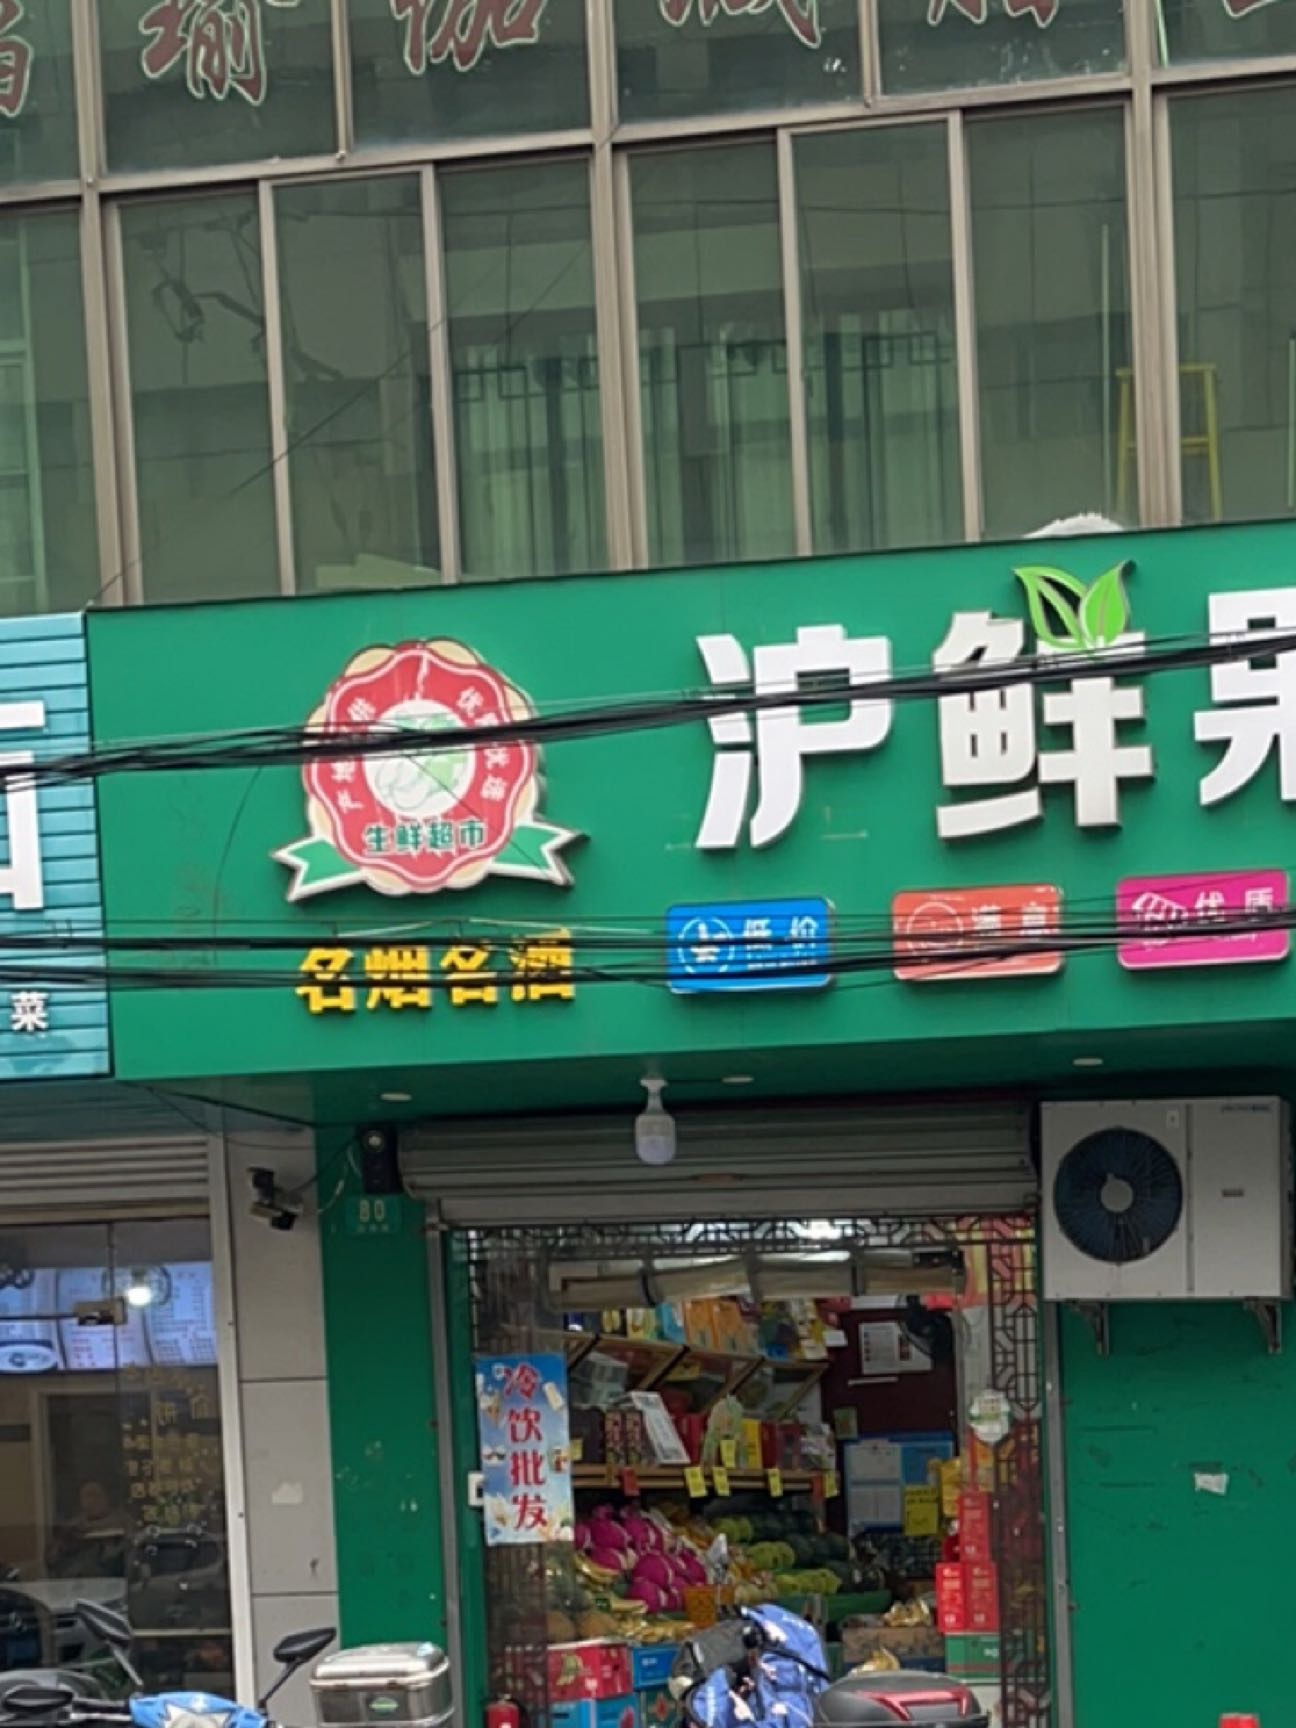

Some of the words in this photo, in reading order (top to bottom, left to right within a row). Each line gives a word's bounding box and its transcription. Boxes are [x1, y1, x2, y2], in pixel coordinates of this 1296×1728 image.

[363, 818, 487, 855] 生鲜超市
[504, 1363, 549, 1530] 冷饮批发
